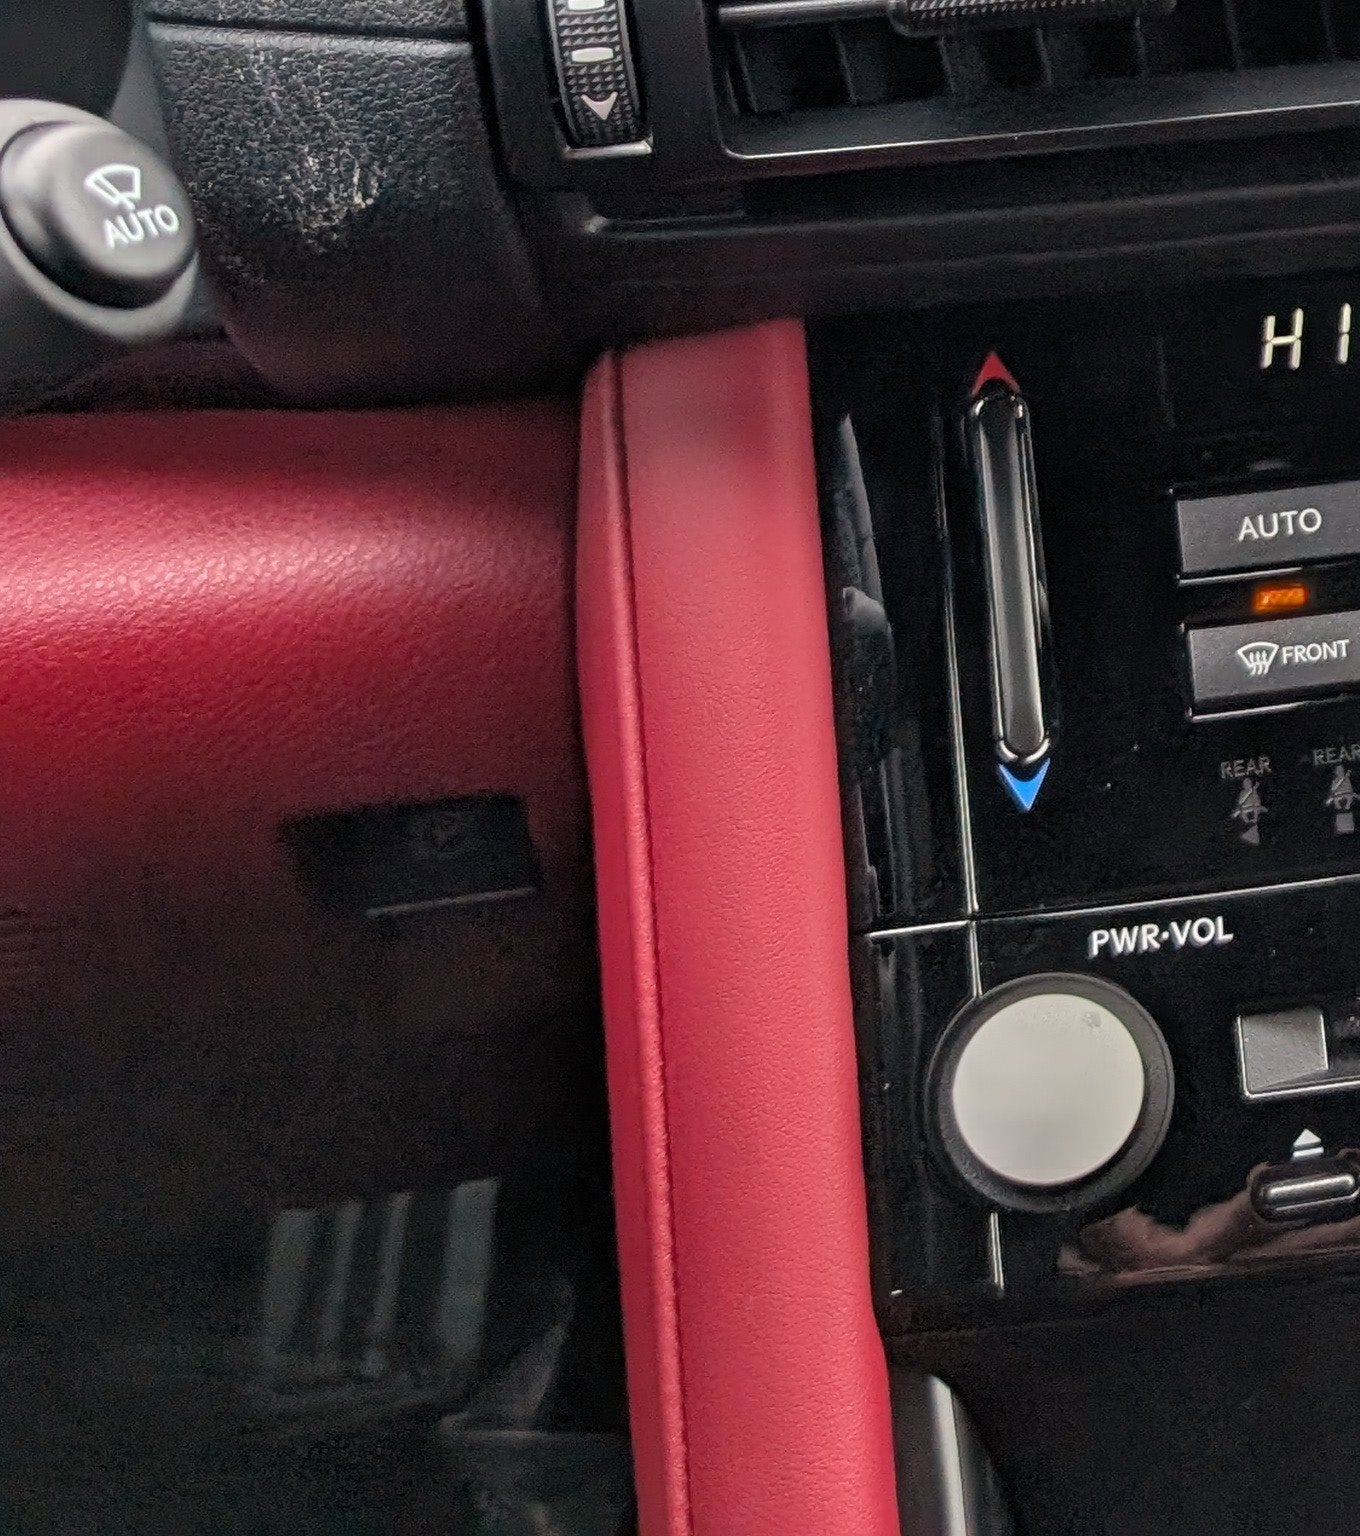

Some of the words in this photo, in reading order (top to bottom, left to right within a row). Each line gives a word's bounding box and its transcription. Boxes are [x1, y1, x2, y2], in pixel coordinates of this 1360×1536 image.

[103, 204, 180, 249] AUTO
[1260, 302, 1352, 370] HI
[1237, 507, 1322, 542] AUTO
[1281, 638, 1350, 665] FRONT
[1221, 756, 1272, 780] REAR
